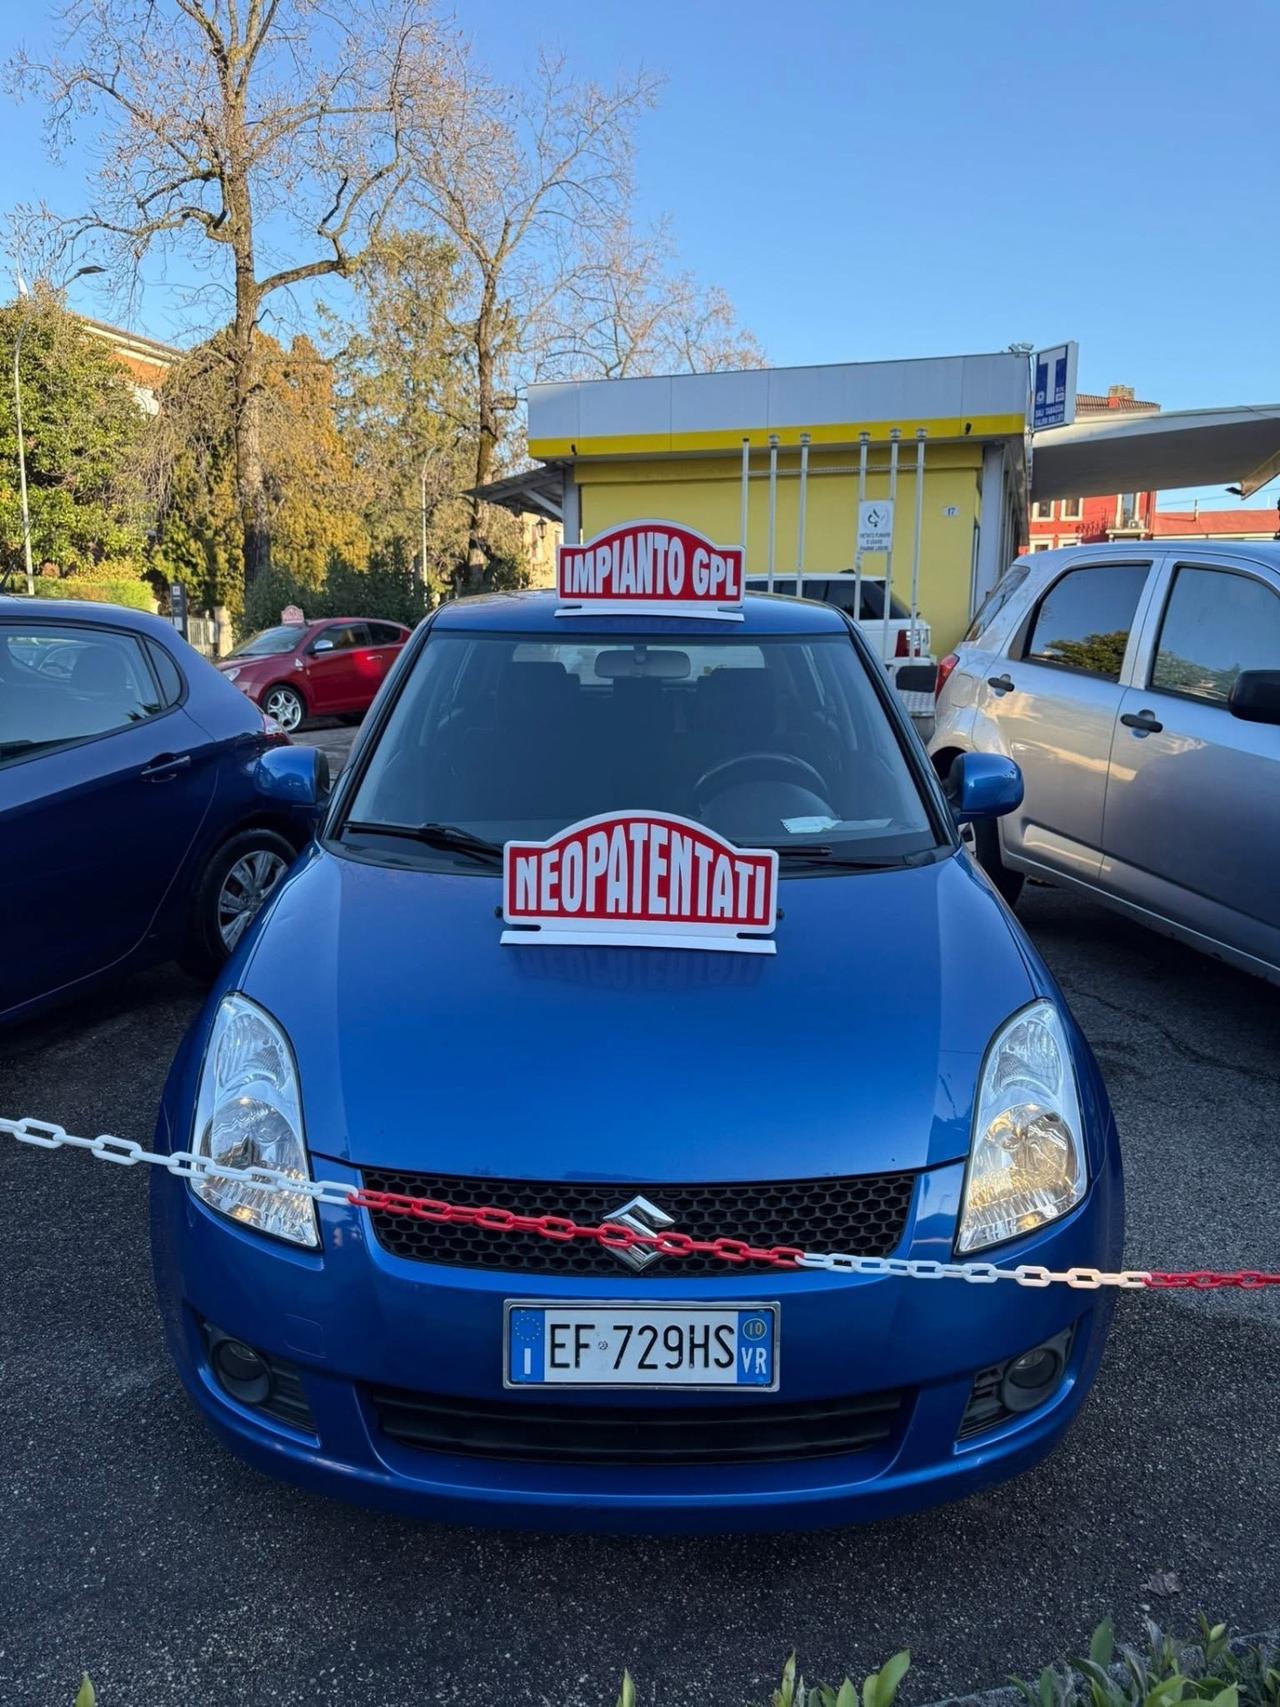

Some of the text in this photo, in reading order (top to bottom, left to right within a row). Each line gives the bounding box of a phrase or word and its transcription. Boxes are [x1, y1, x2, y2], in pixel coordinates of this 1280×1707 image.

[1038, 345, 1066, 405] T
[564, 531, 738, 596] IMPIANTO GPL
[515, 822, 766, 920] NEOPATENTATI
[550, 1323, 596, 1369] EF
[612, 1324, 735, 1370] 729HS
[741, 1347, 767, 1375] VR
[747, 1322, 763, 1335] 10
